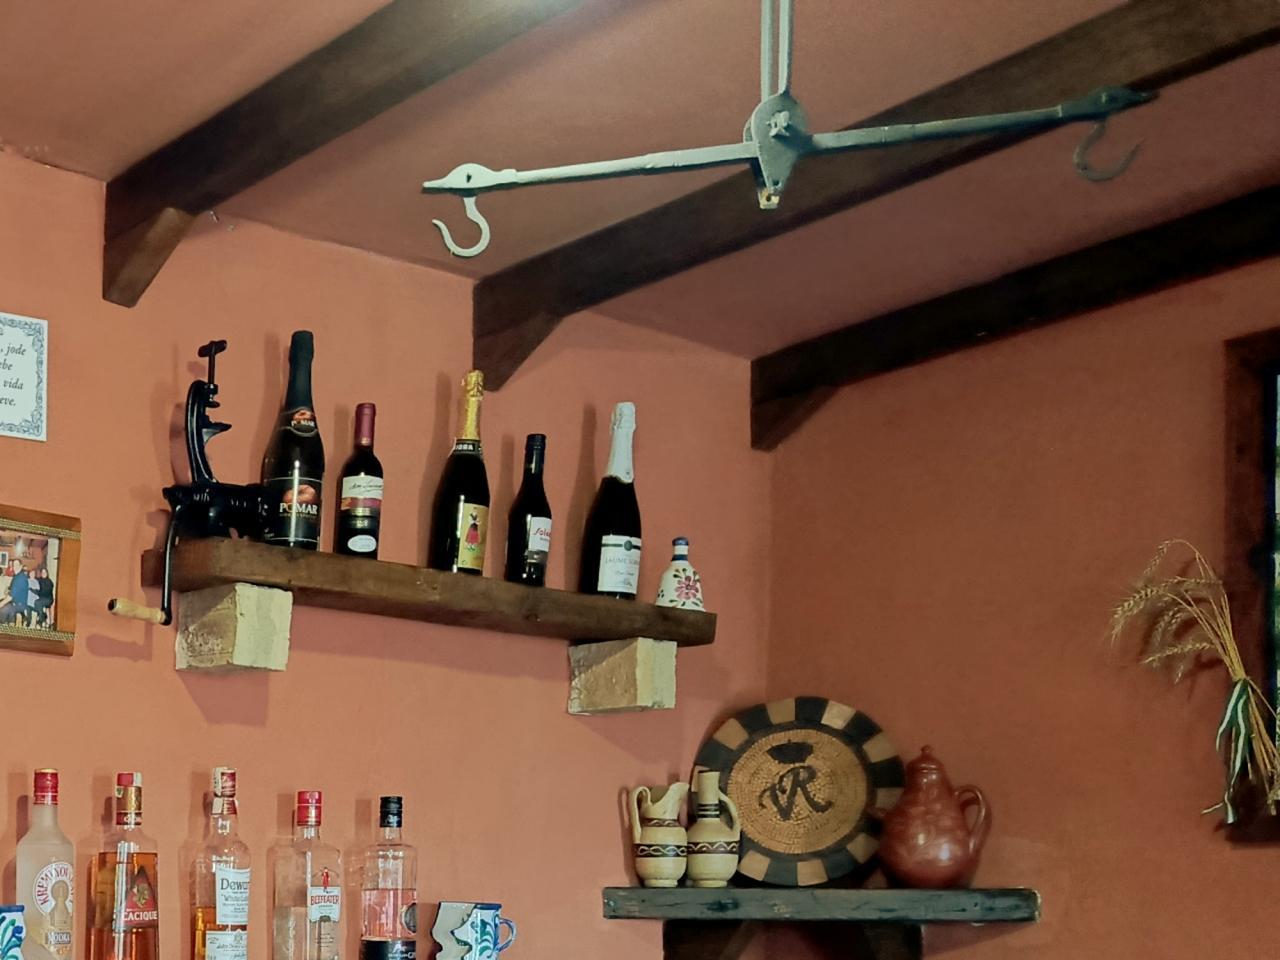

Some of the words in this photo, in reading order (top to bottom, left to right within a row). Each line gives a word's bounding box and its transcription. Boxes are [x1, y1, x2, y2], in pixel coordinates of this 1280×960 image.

[4, 342, 26, 356] jode
[3, 377, 24, 390] vida
[279, 502, 318, 515] POMAR
[310, 894, 340, 905] BEEFEATER
[123, 910, 158, 921] CACIQUE
